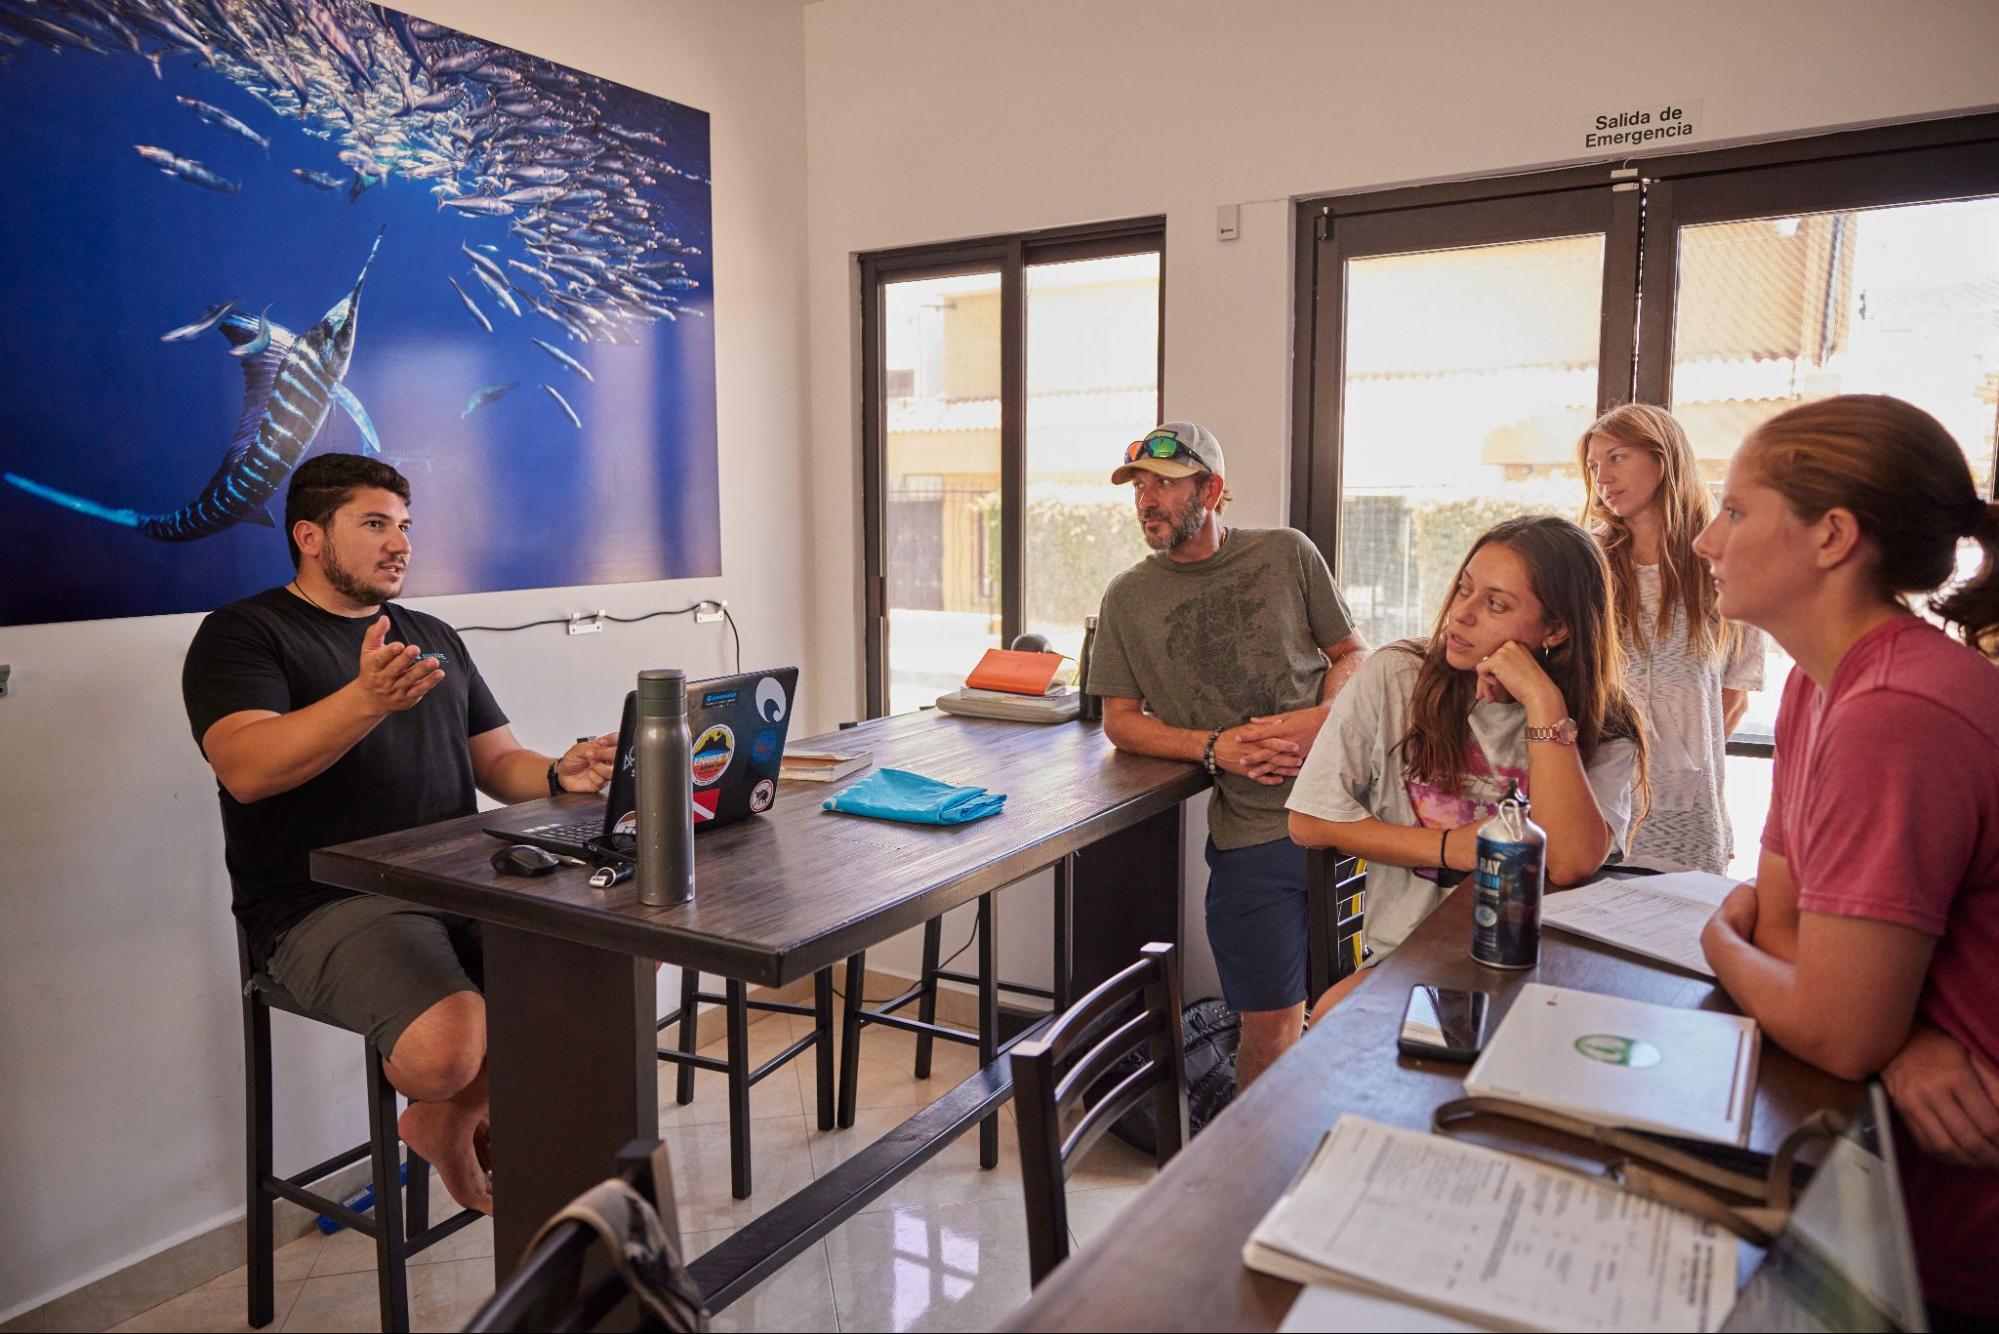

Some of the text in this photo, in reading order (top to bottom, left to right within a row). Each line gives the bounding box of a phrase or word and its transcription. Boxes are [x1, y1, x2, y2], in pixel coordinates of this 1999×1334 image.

[1595, 106, 1683, 130] Salida de
[1585, 122, 1693, 148] Emergencia
